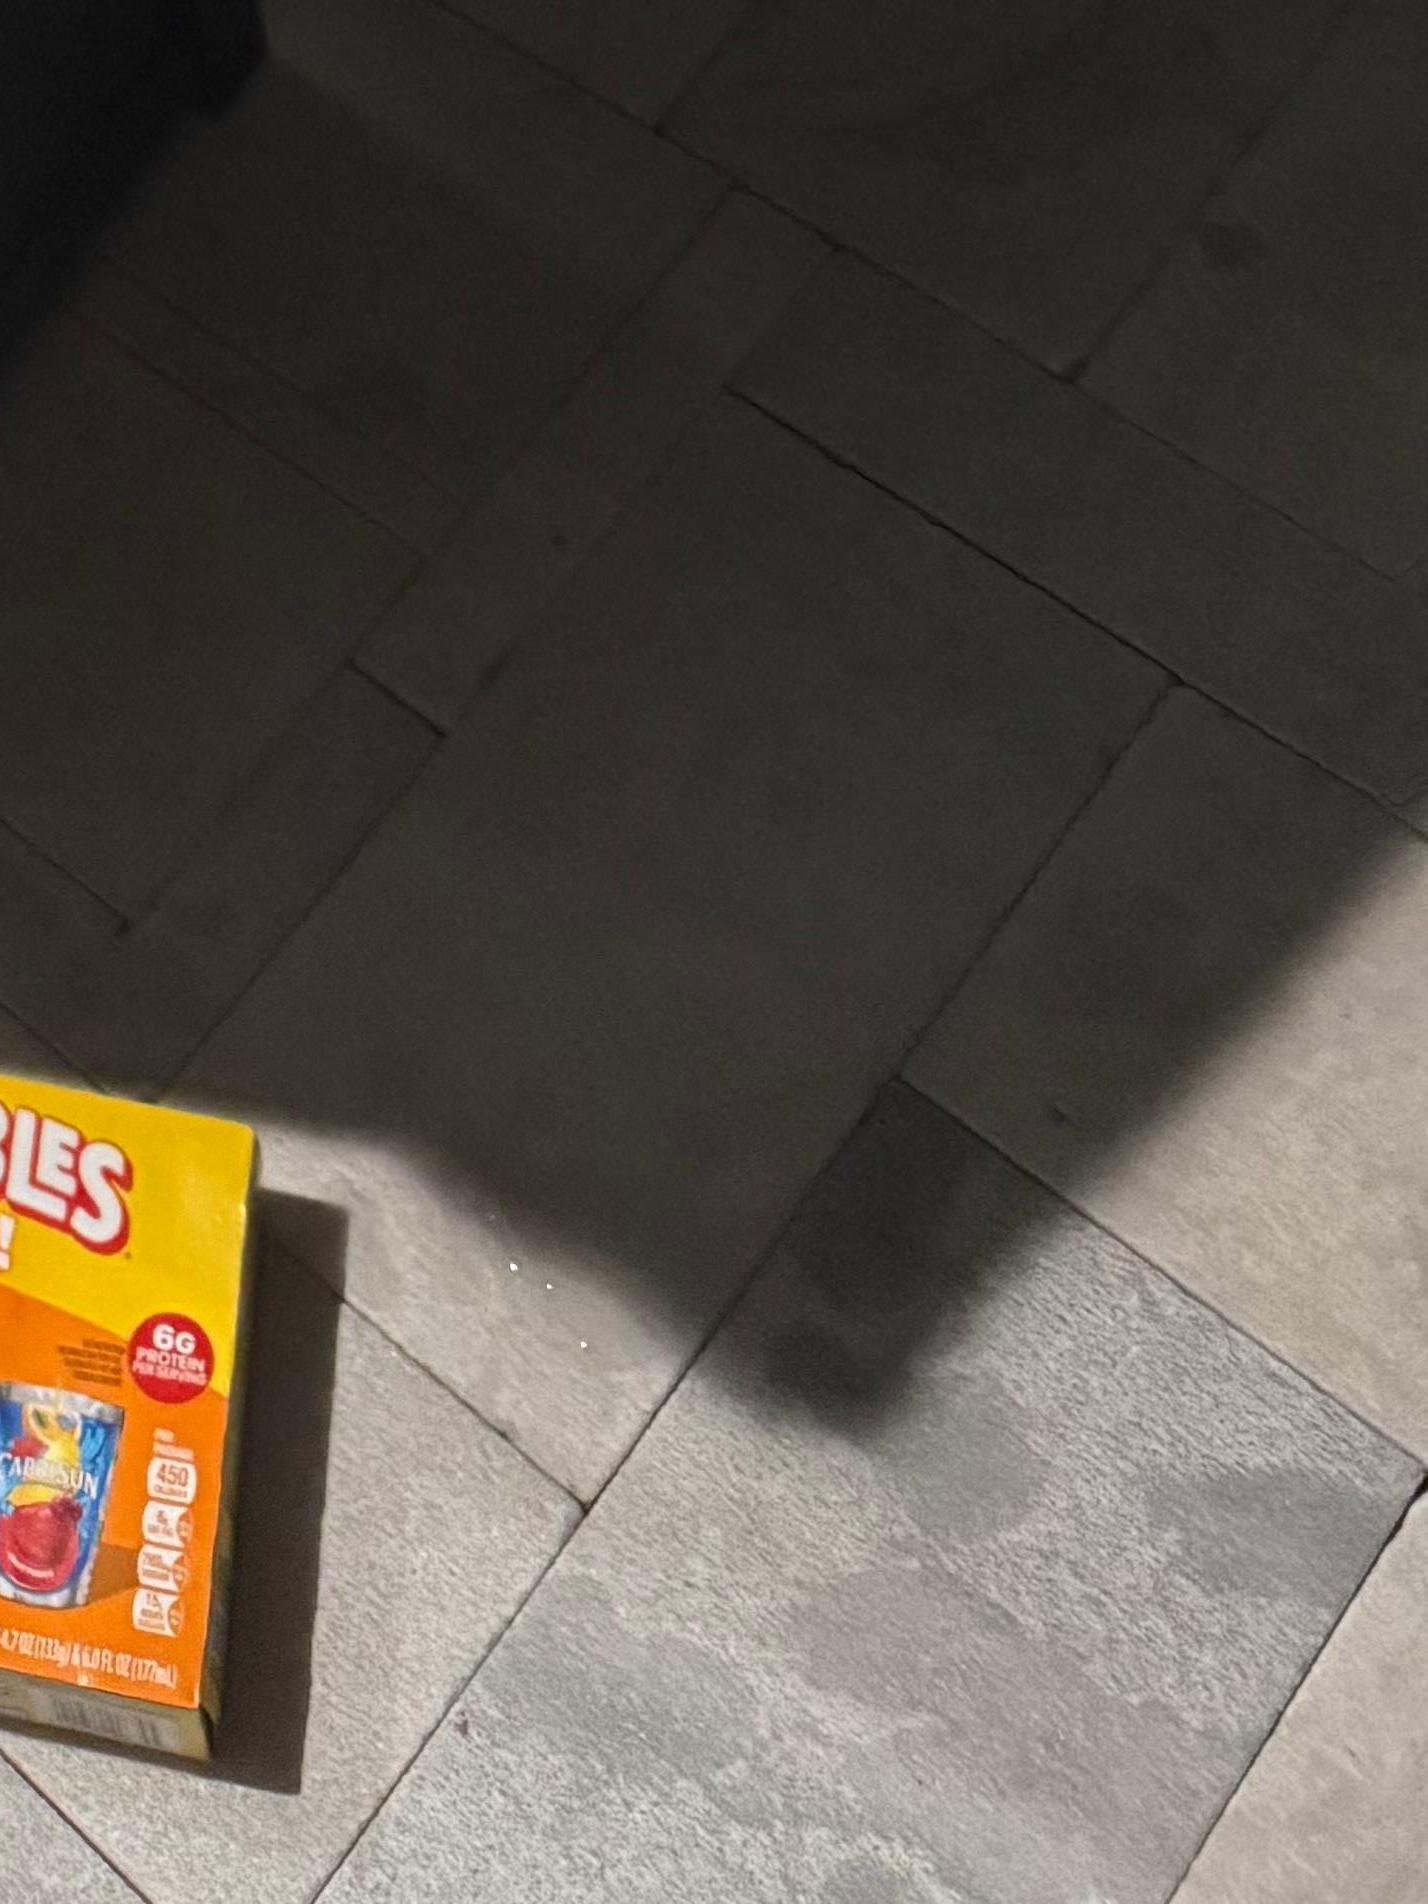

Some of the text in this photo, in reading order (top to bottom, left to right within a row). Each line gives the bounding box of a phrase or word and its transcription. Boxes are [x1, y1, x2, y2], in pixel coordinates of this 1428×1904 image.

[150, 1322, 198, 1356] 6G
[134, 1346, 206, 1373] PROTEIN
[155, 1462, 190, 1488] 450
